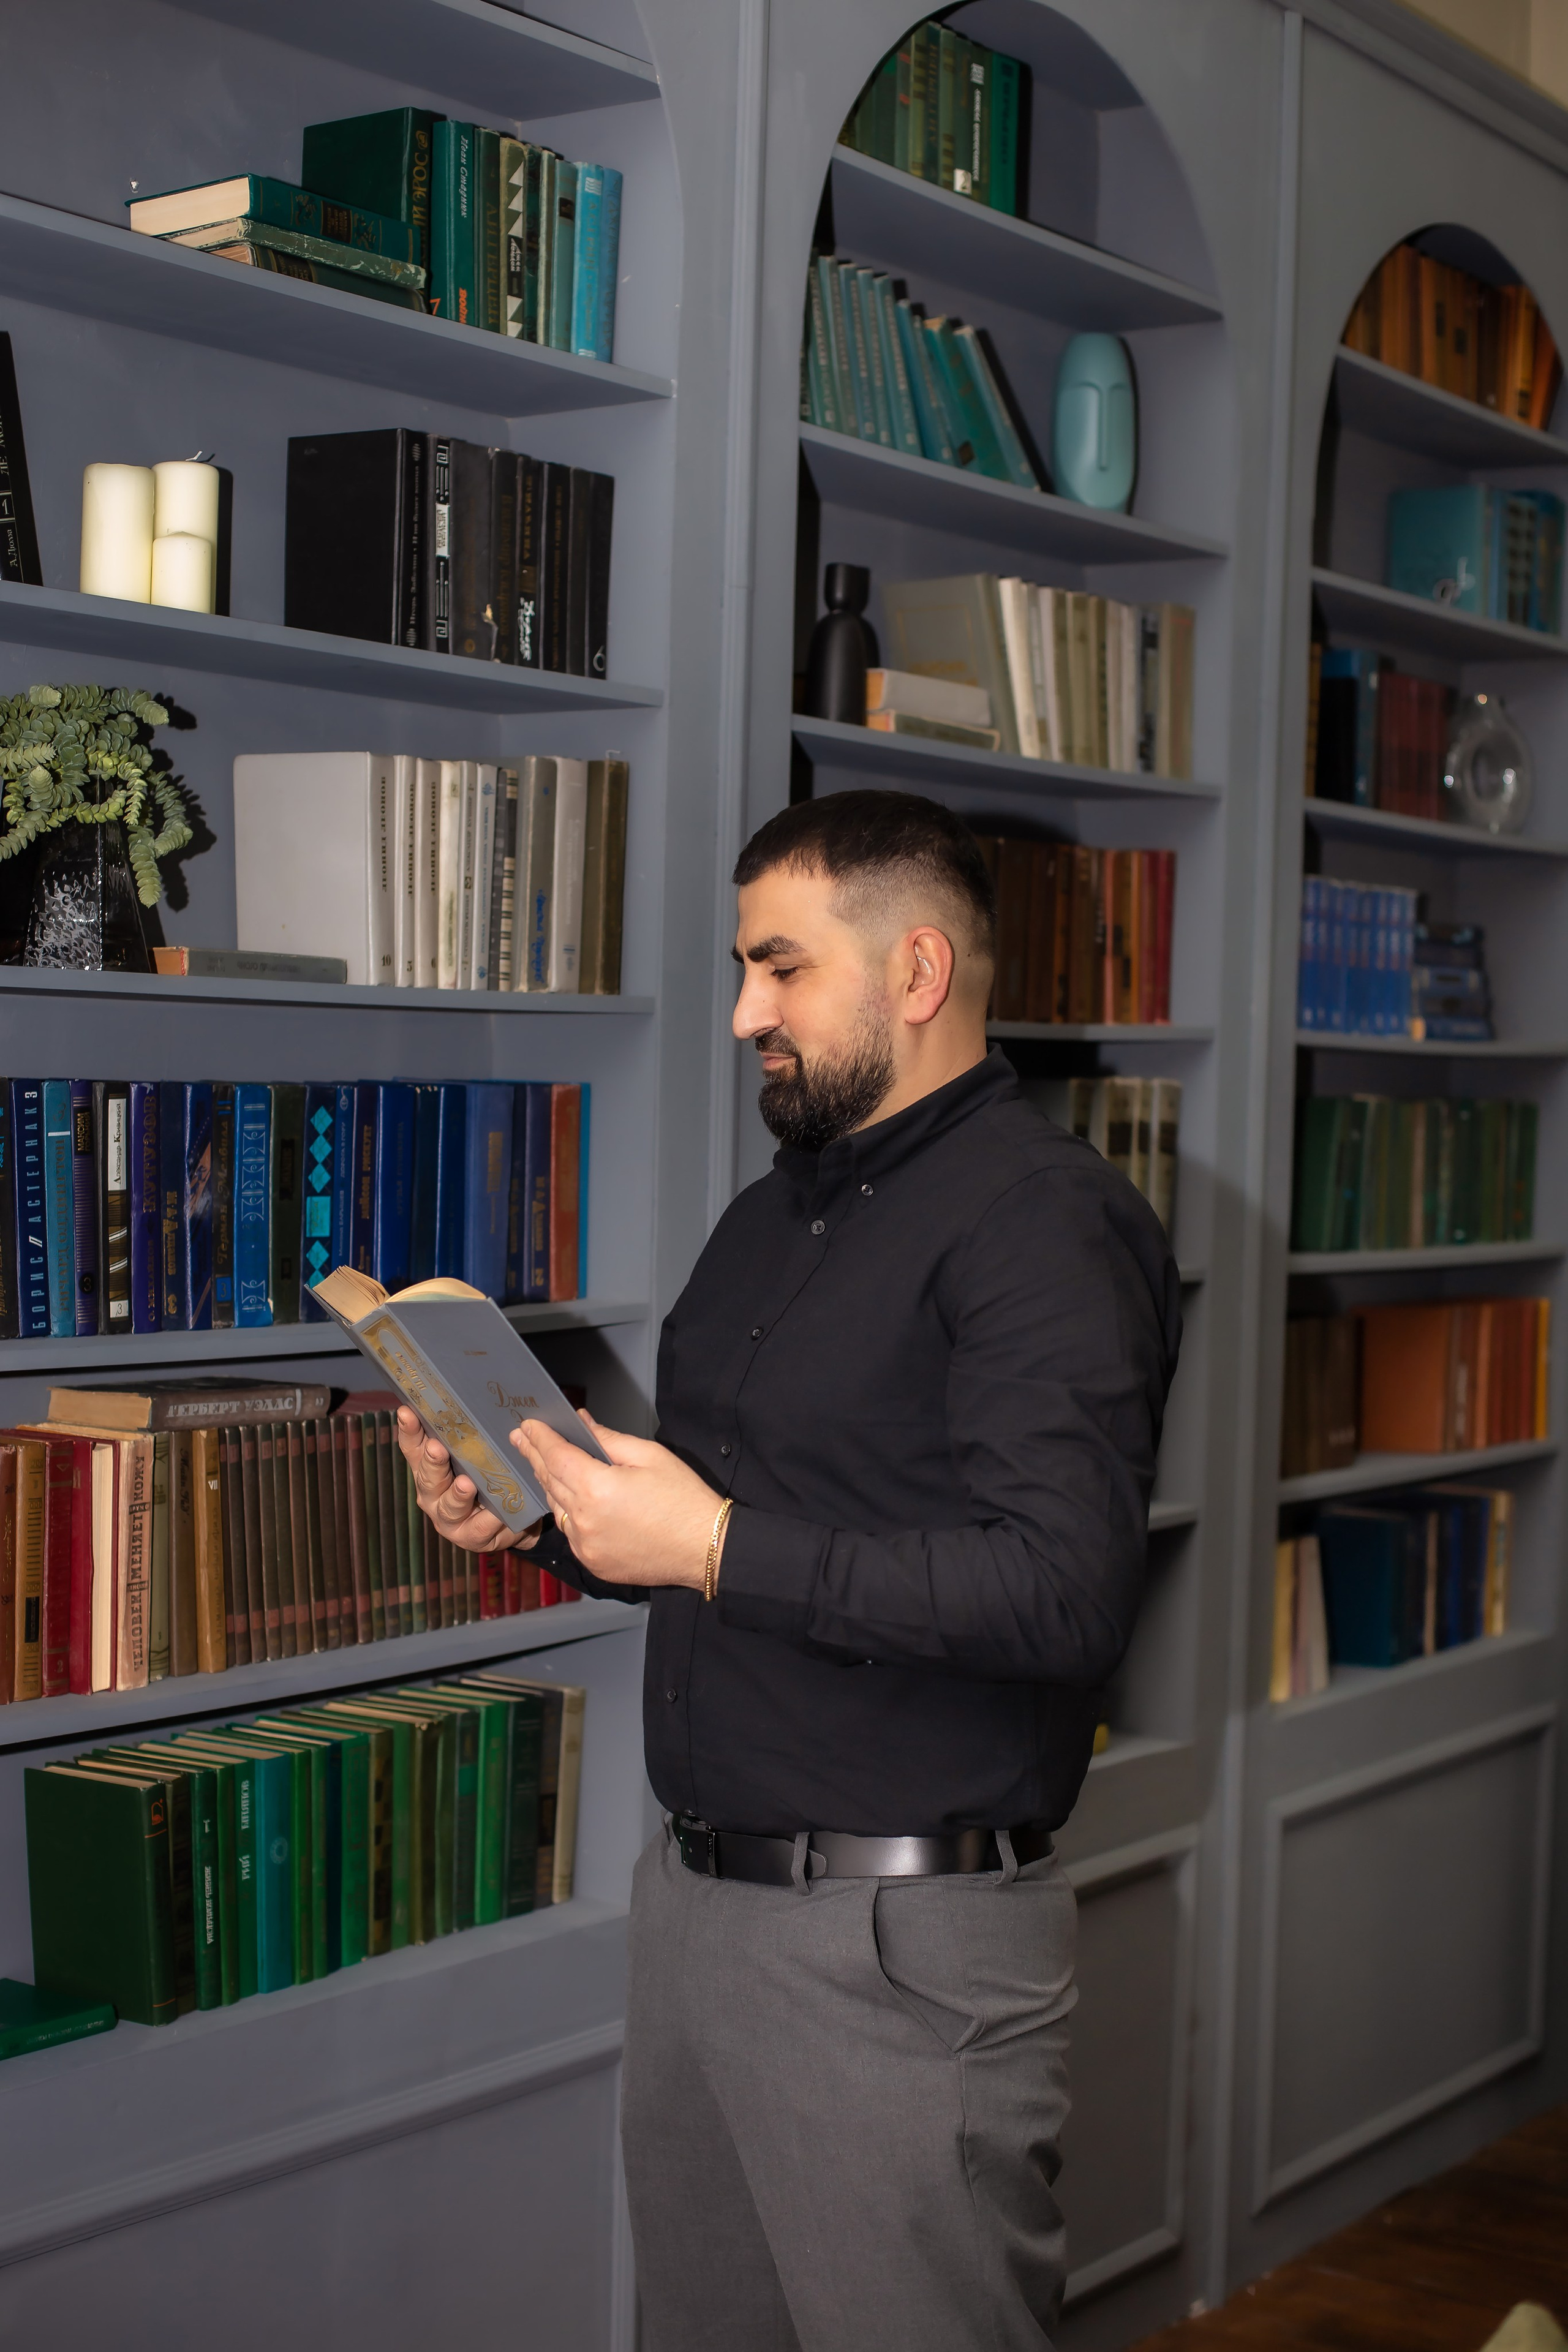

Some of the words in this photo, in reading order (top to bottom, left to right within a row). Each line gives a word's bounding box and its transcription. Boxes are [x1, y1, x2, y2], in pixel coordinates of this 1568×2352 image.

[412, 151, 429, 206] ЭРОС
[381, 954, 391, 966] 10
[407, 960, 412, 972] 5
[143, 1095, 157, 1213] КУТУЗОВ
[218, 1205, 228, 1264] Герман
[30, 1256, 46, 1329] БОРИС
[116, 1302, 123, 1316] 3
[166, 1400, 240, 1417] ГЕРБЕРТ
[244, 1396, 294, 1412] УЭЛЛС
[487, 1381, 540, 1408] Джен
[133, 1456, 145, 1502] КОЖУ
[208, 1480, 218, 1490] VII
[130, 1513, 143, 1580] МЕНЯЕТ
[130, 1593, 144, 1673] ЧЕЛОВЕК
